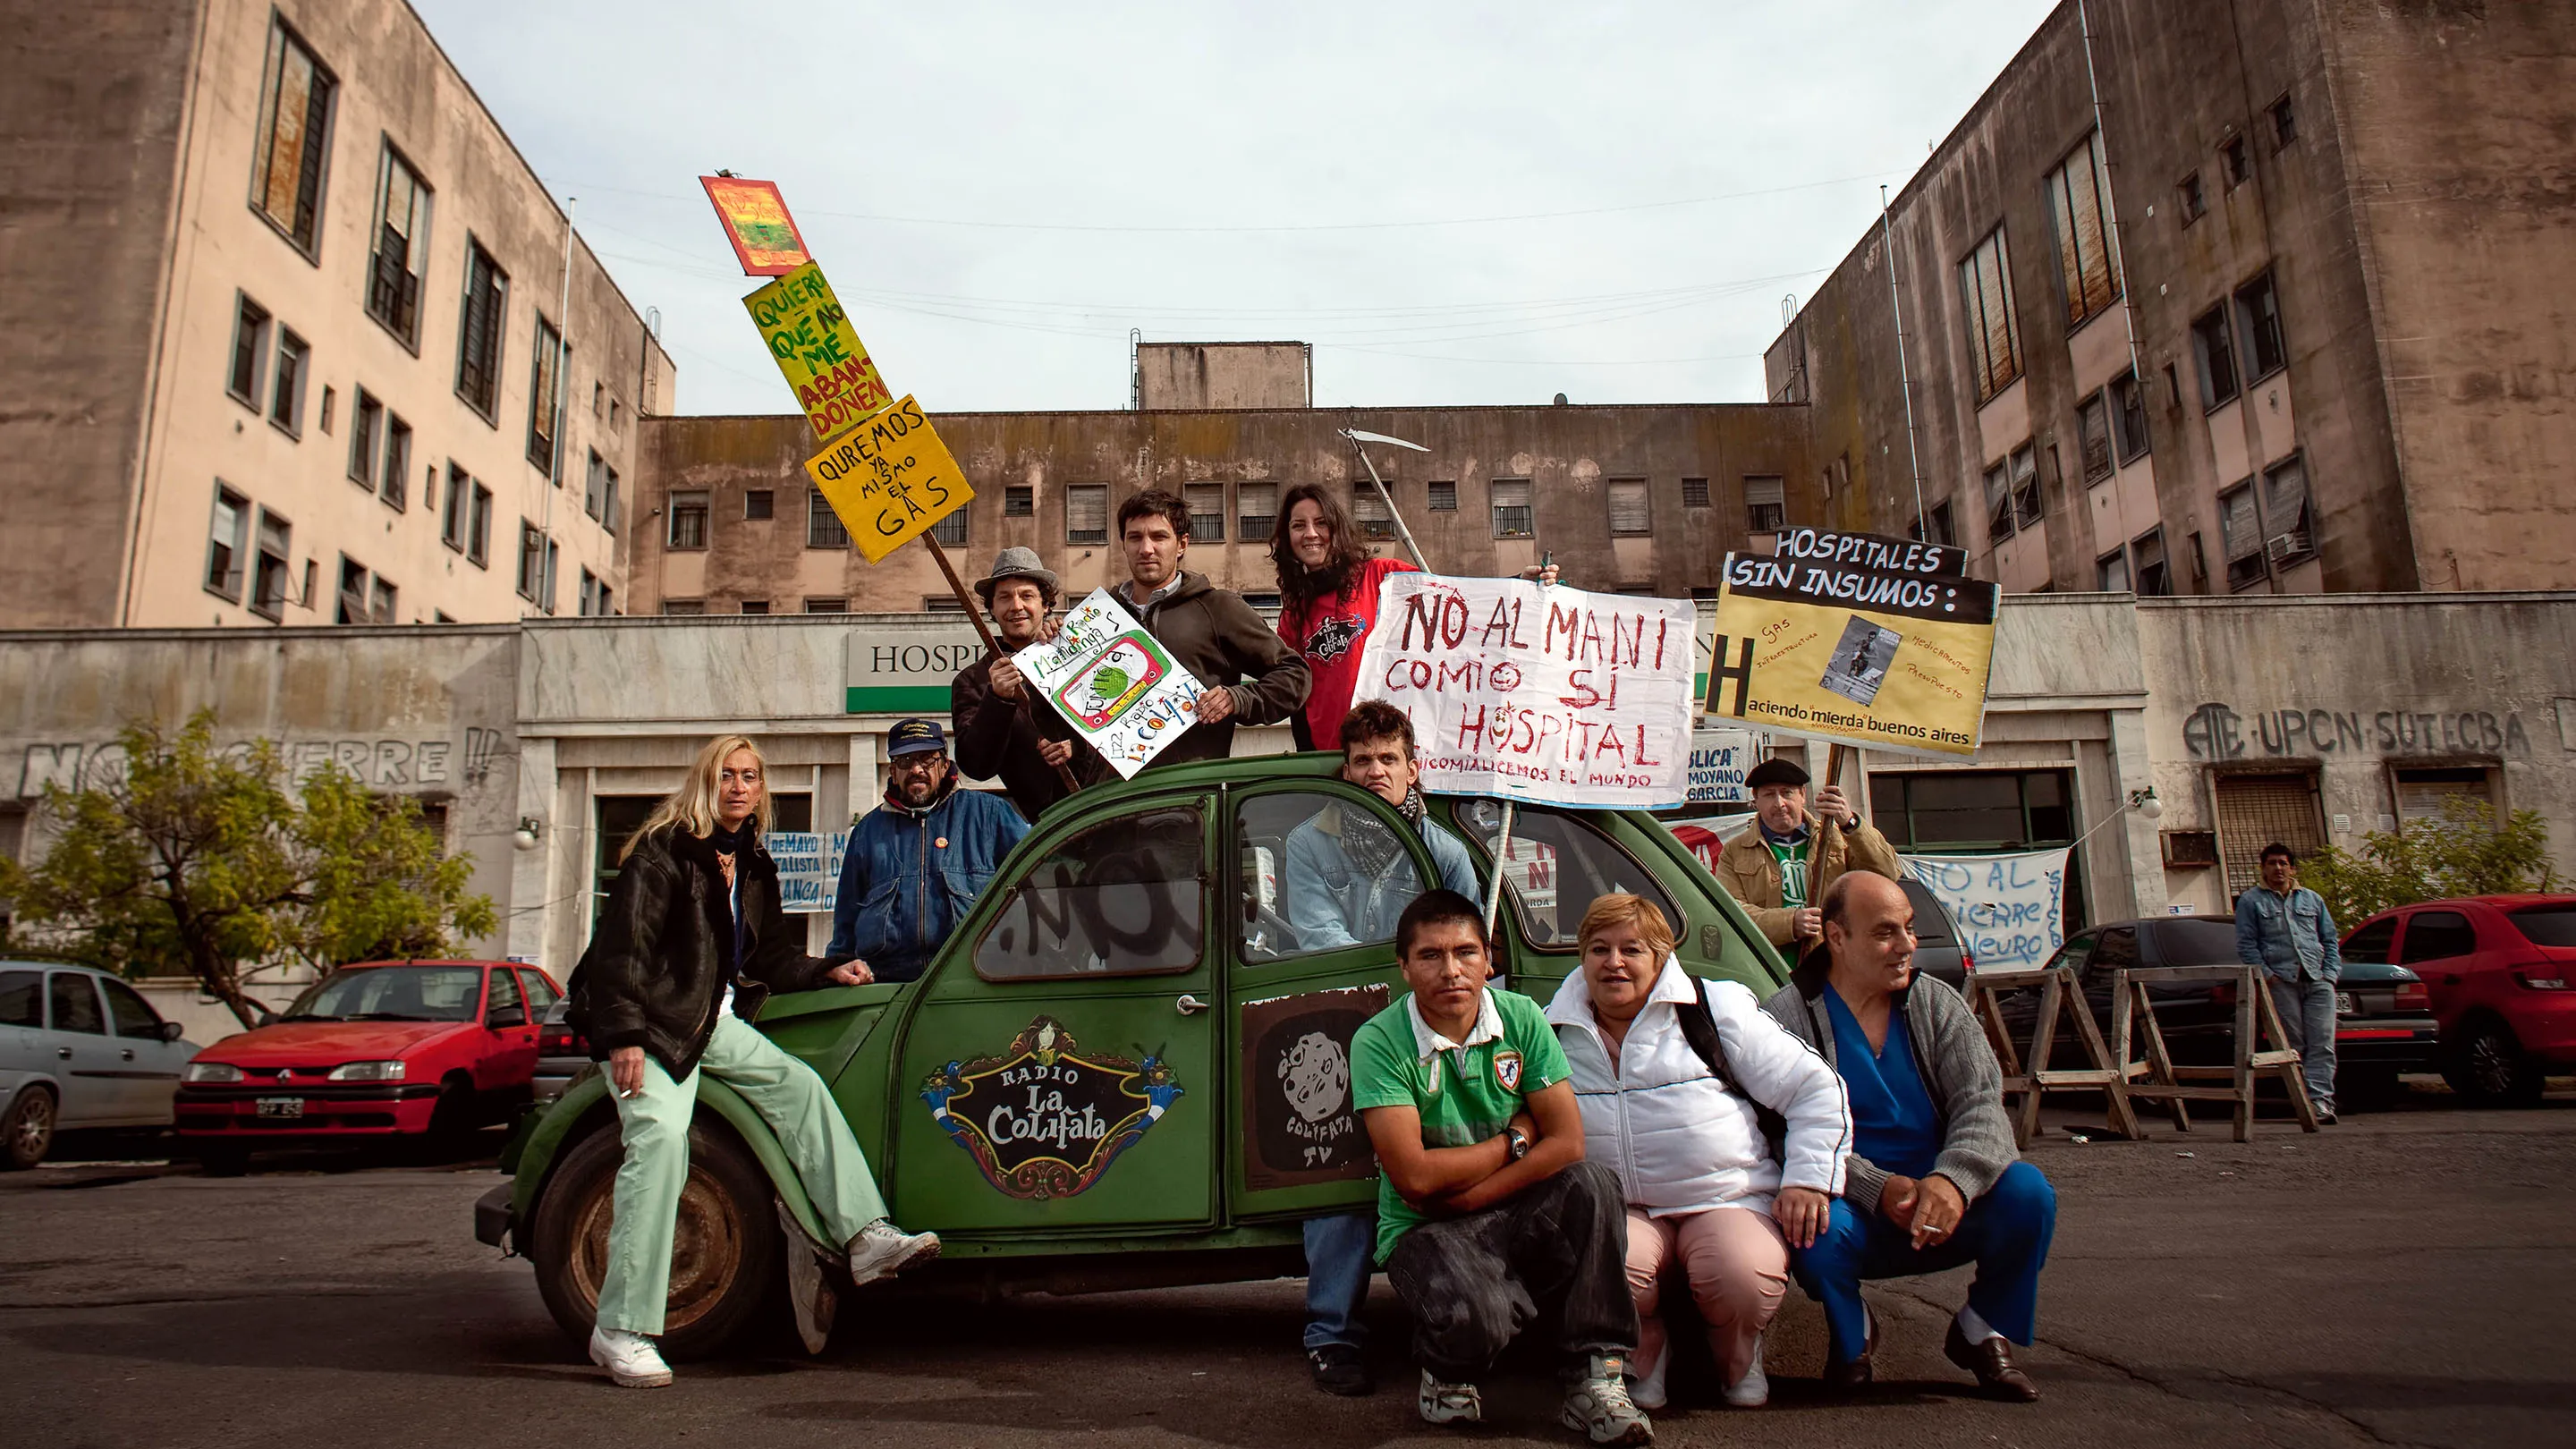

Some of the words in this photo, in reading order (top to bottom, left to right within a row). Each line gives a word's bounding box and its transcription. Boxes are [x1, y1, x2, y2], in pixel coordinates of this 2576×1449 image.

[753, 269, 825, 328] QUIERO
[816, 302, 843, 334] NO
[802, 332, 851, 377] ME
[811, 376, 888, 436] DONEN
[818, 400, 924, 481] QUREMOS
[861, 455, 916, 499] MISMO
[869, 456, 890, 474] YA
[887, 481, 911, 498] EL
[876, 476, 949, 537] GAS
[1775, 529, 1942, 573] HOSPITALES
[1731, 560, 1795, 588] SIN
[1401, 587, 1471, 653] NO
[1481, 596, 1529, 649] AL
[871, 644, 987, 673] HOSPI
[1458, 700, 1661, 769] HOSPITAL
[1868, 716, 1926, 738] buenos
[1930, 727, 1969, 745] aires
[1560, 769, 1577, 784] EL
[1589, 772, 1651, 789] MUNDO
[1688, 769, 1744, 785] MOYANO
[1688, 786, 1740, 801] GARCIA
[1987, 860, 2036, 892] AL
[1000, 1065, 1079, 1087] RADIO
[1025, 1085, 1063, 1113] La
[1304, 1146, 1332, 1166] TV
